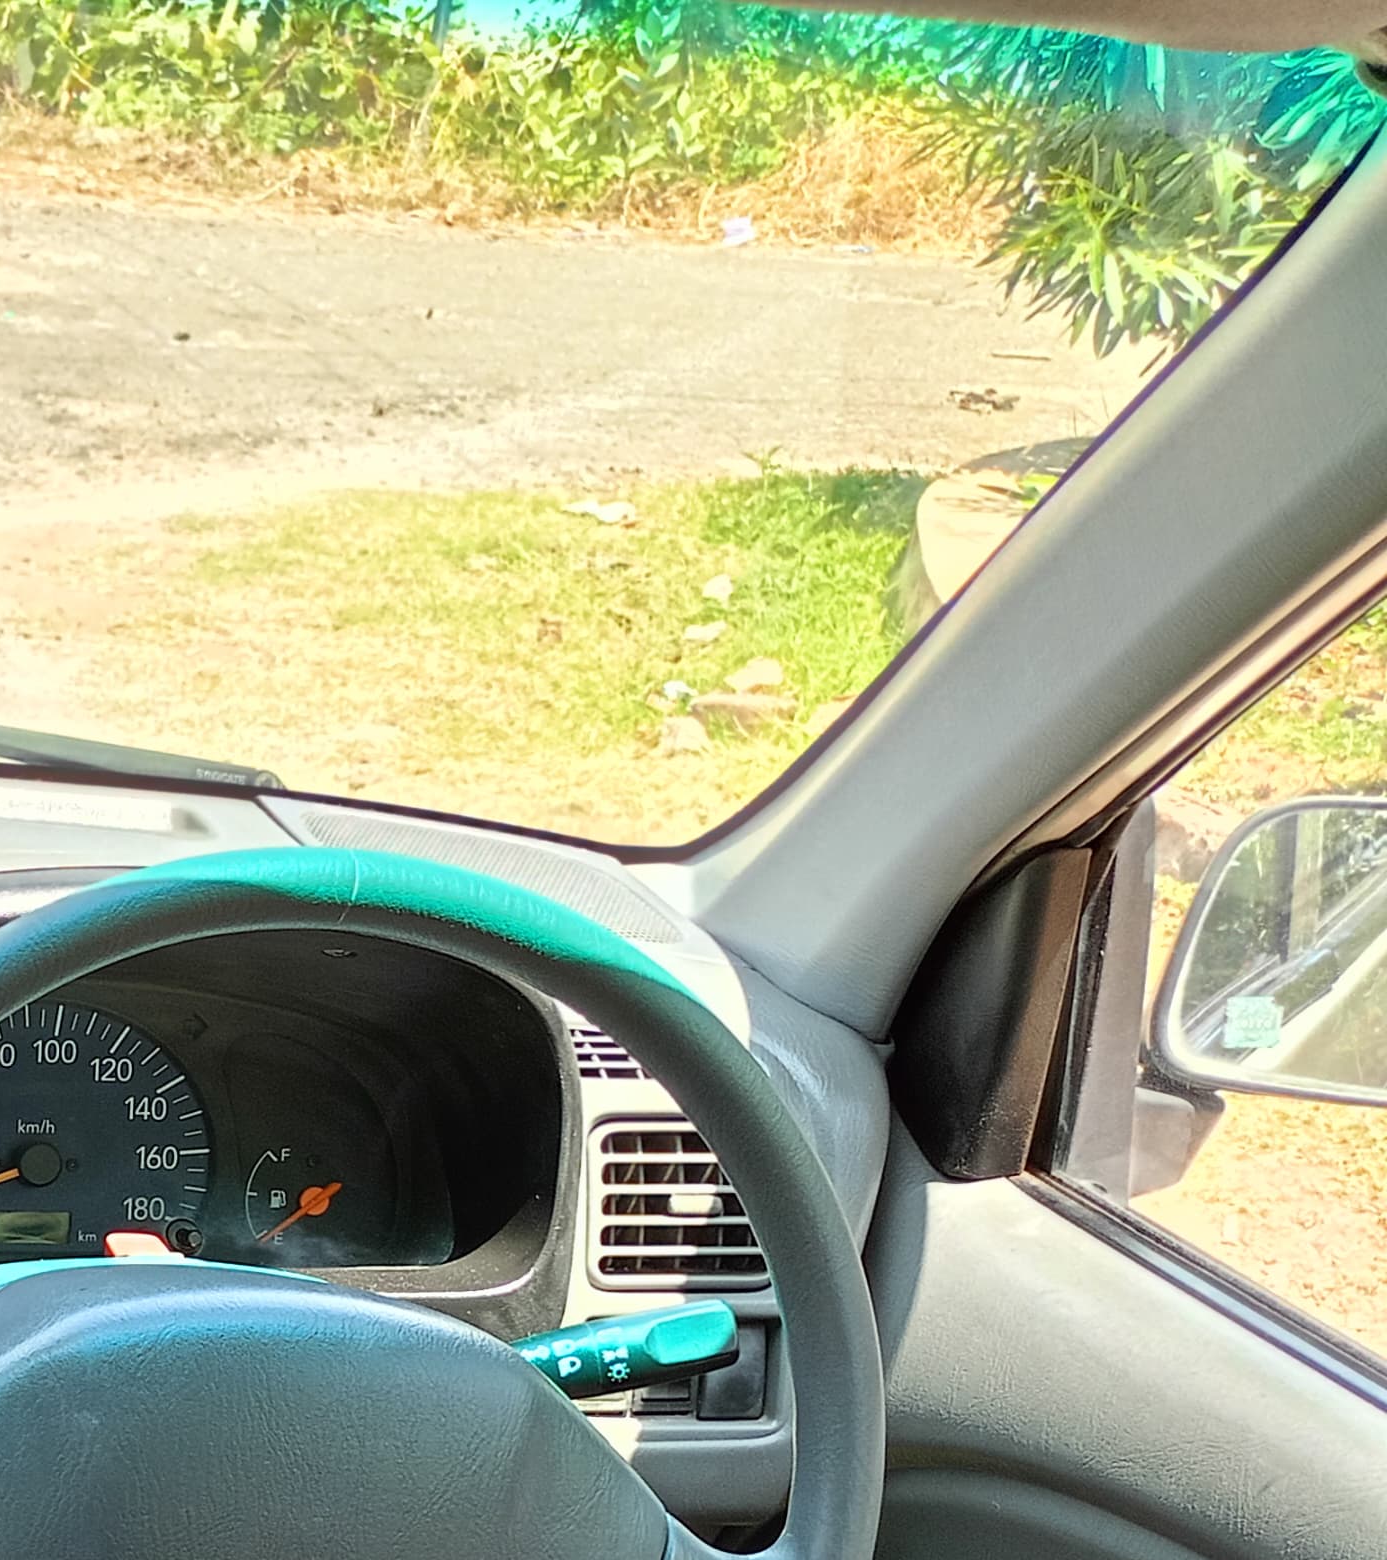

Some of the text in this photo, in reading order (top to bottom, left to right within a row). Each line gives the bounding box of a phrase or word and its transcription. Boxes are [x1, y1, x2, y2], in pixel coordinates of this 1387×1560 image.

[32, 1039, 77, 1064] 100
[90, 1058, 133, 1082] 120
[124, 1096, 167, 1121] 140
[17, 1118, 56, 1135] km/h
[135, 1146, 179, 1170] 160
[281, 1148, 292, 1161] F
[123, 1197, 165, 1221] 180
[77, 1230, 97, 1243] km
[274, 1231, 284, 1245] E
